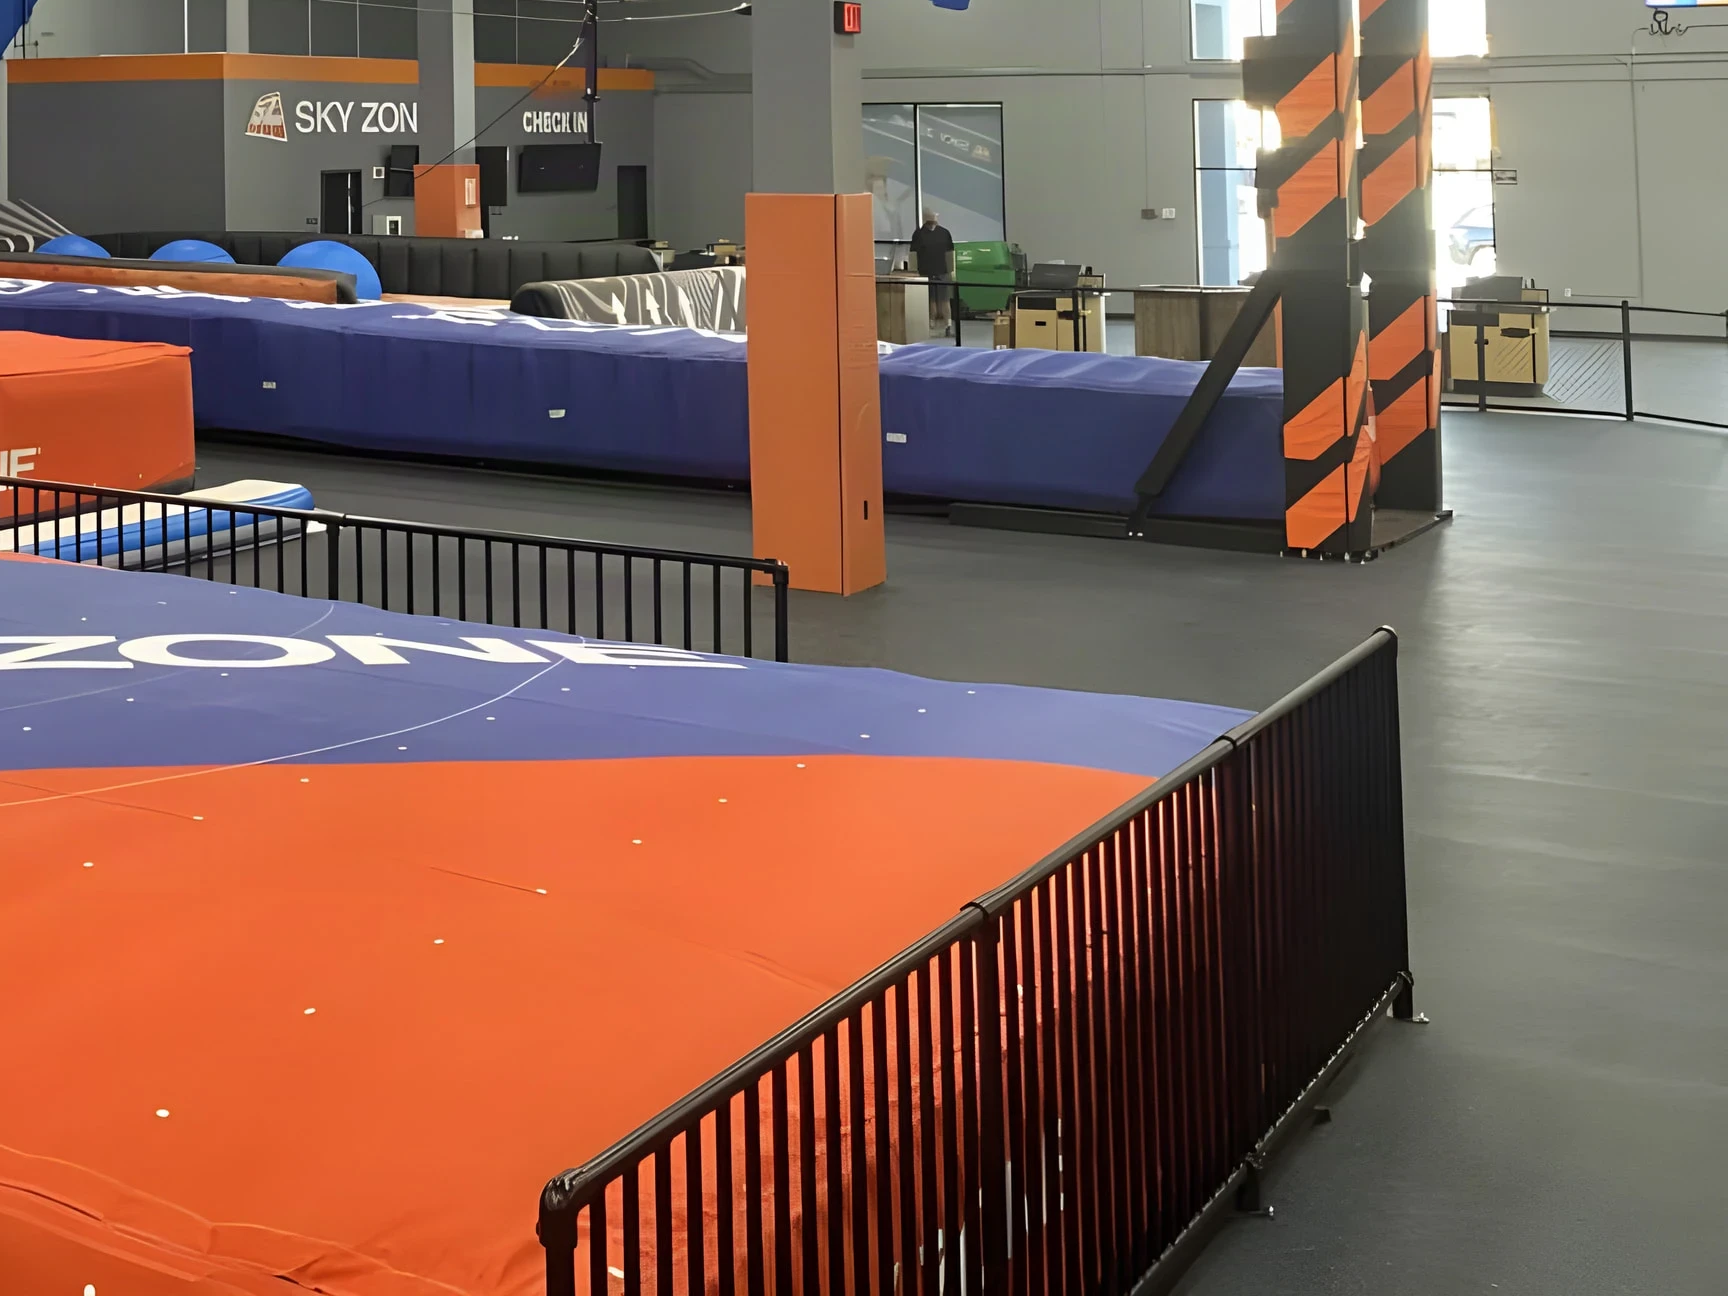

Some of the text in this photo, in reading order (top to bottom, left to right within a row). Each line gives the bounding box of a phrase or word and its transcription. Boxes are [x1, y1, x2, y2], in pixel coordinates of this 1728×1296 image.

[295, 100, 419, 134] SKY ZON
[522, 111, 588, 133] CHECK IN
